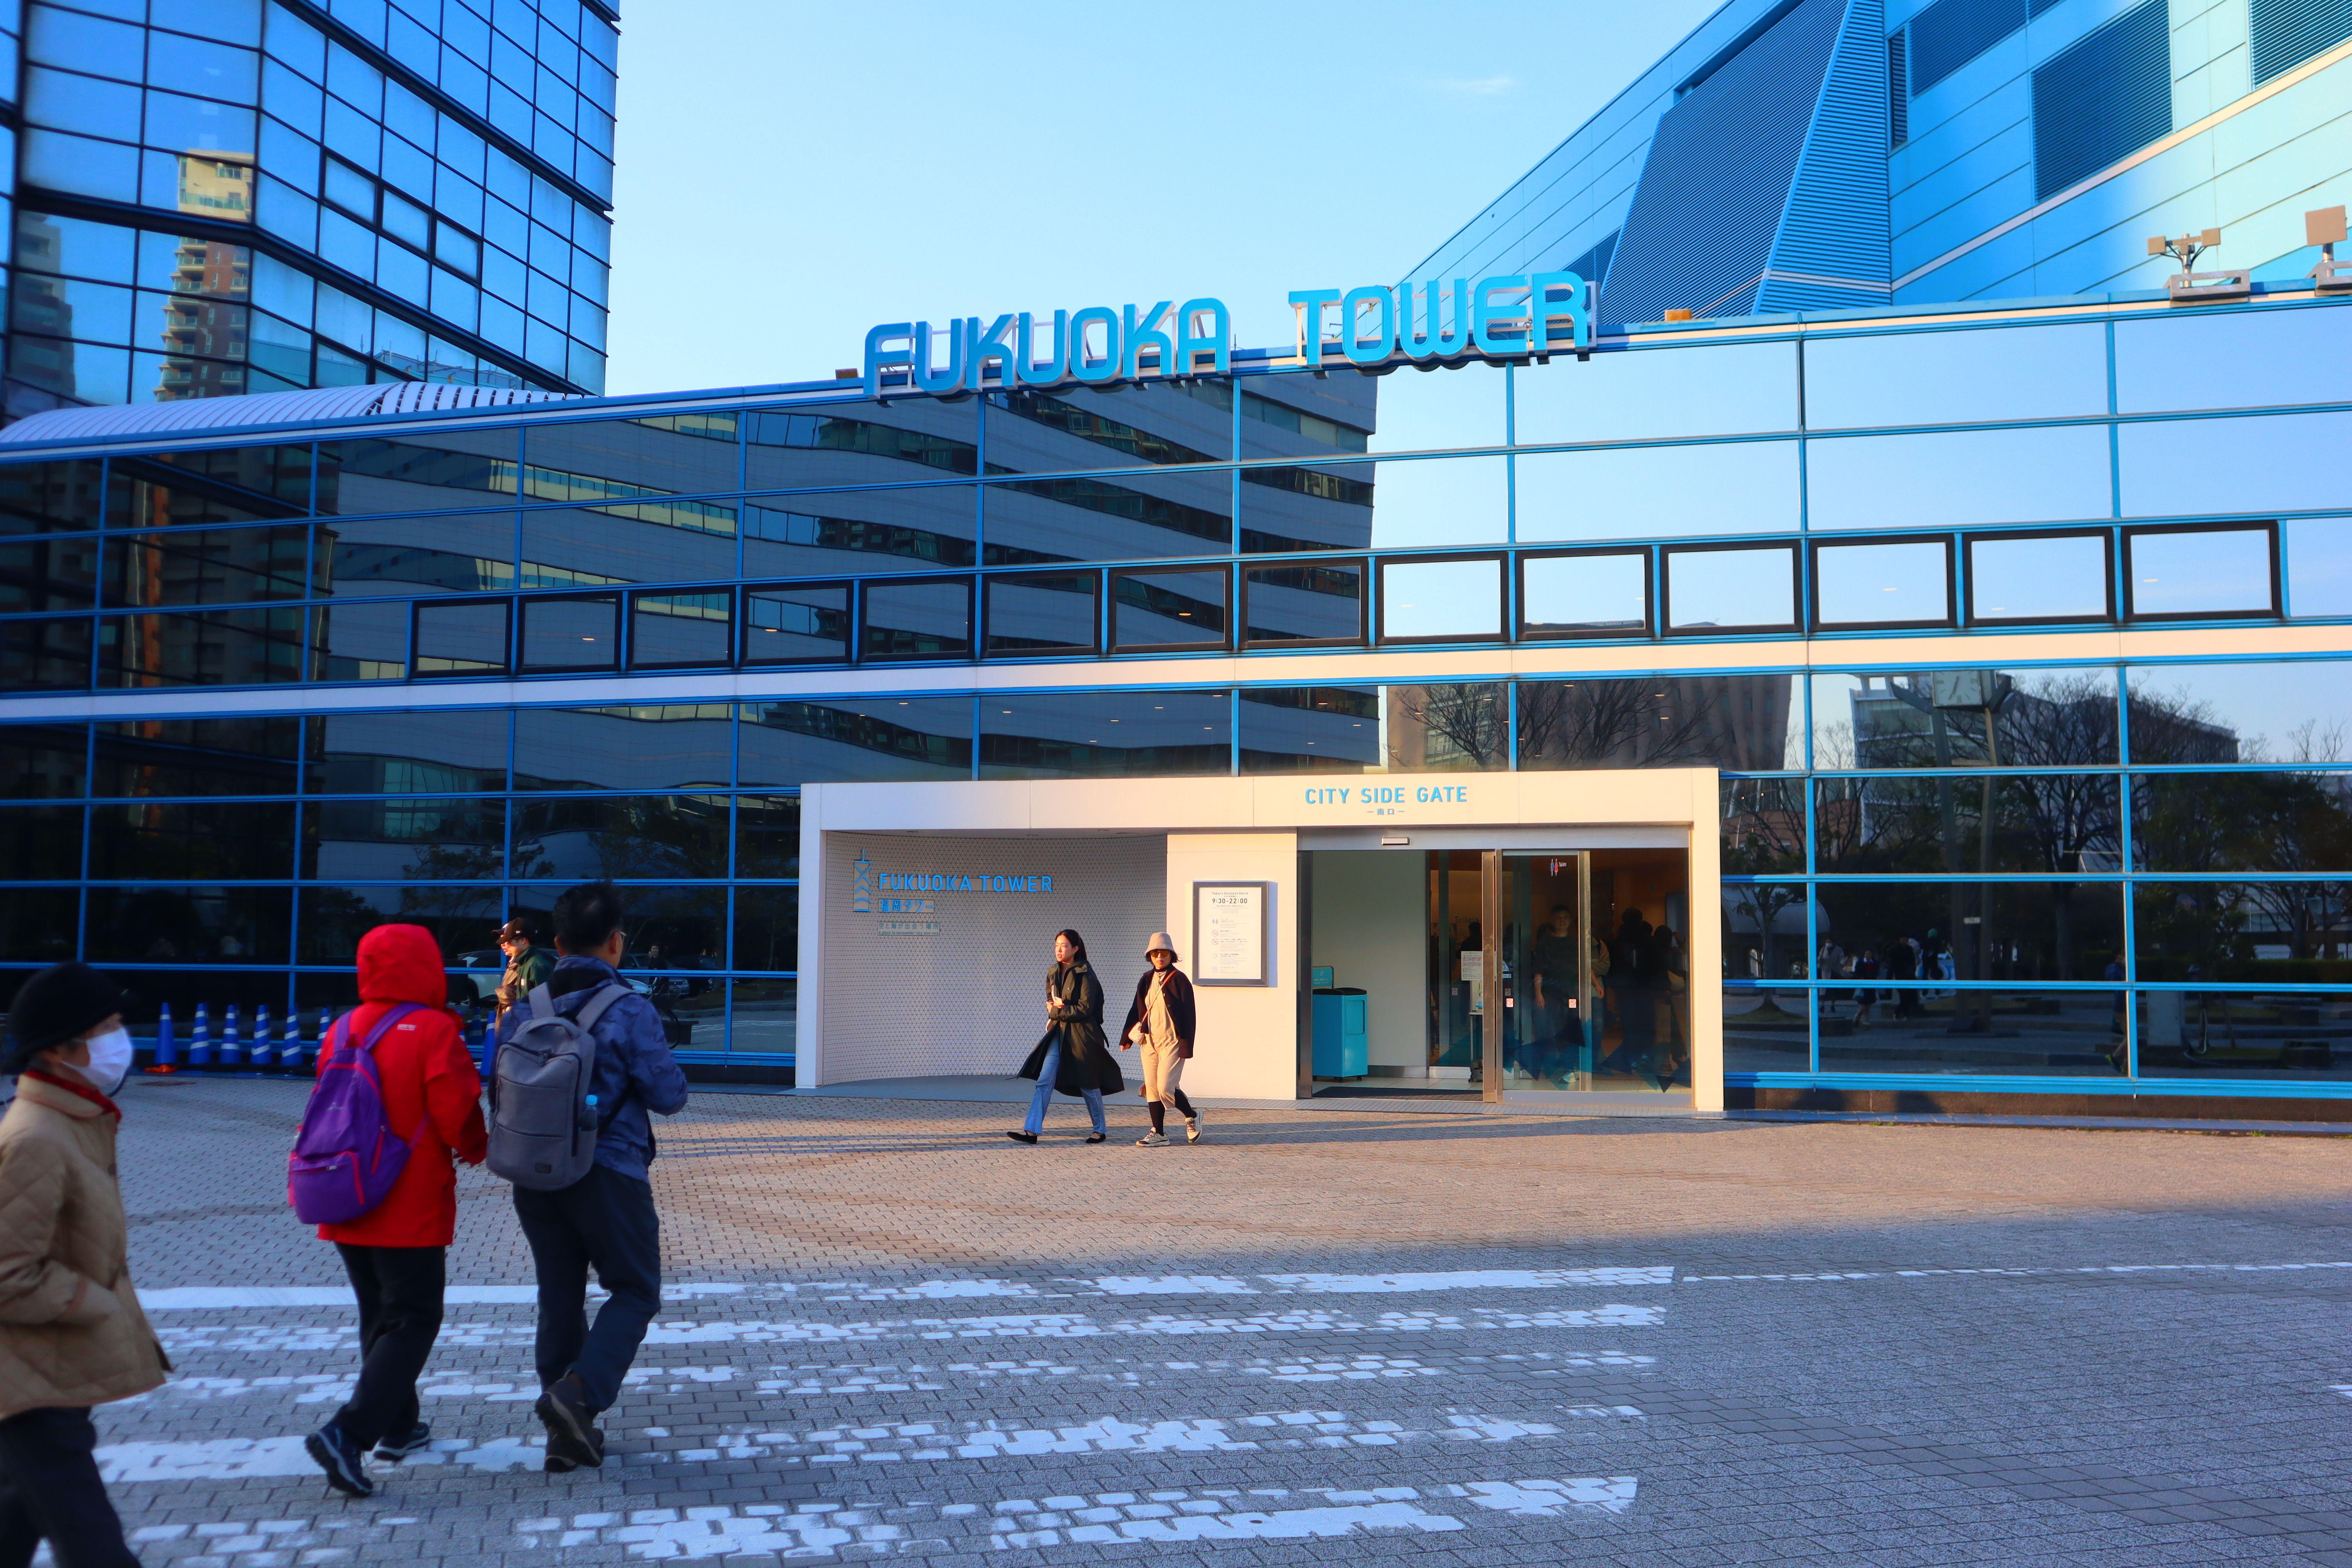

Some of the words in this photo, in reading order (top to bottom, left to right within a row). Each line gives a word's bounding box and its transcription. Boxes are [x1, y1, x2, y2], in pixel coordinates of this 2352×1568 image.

[863, 297, 1231, 400] FUKUOKA
[1288, 270, 1589, 369] TOWER
[1305, 788, 1350, 804] CITY
[1361, 787, 1405, 803] SIDE
[1416, 786, 1467, 802] GATE
[879, 873, 972, 891] FUKUOKA
[979, 875, 1053, 892] TOWER
[880, 899, 936, 913] 福岡タワー
